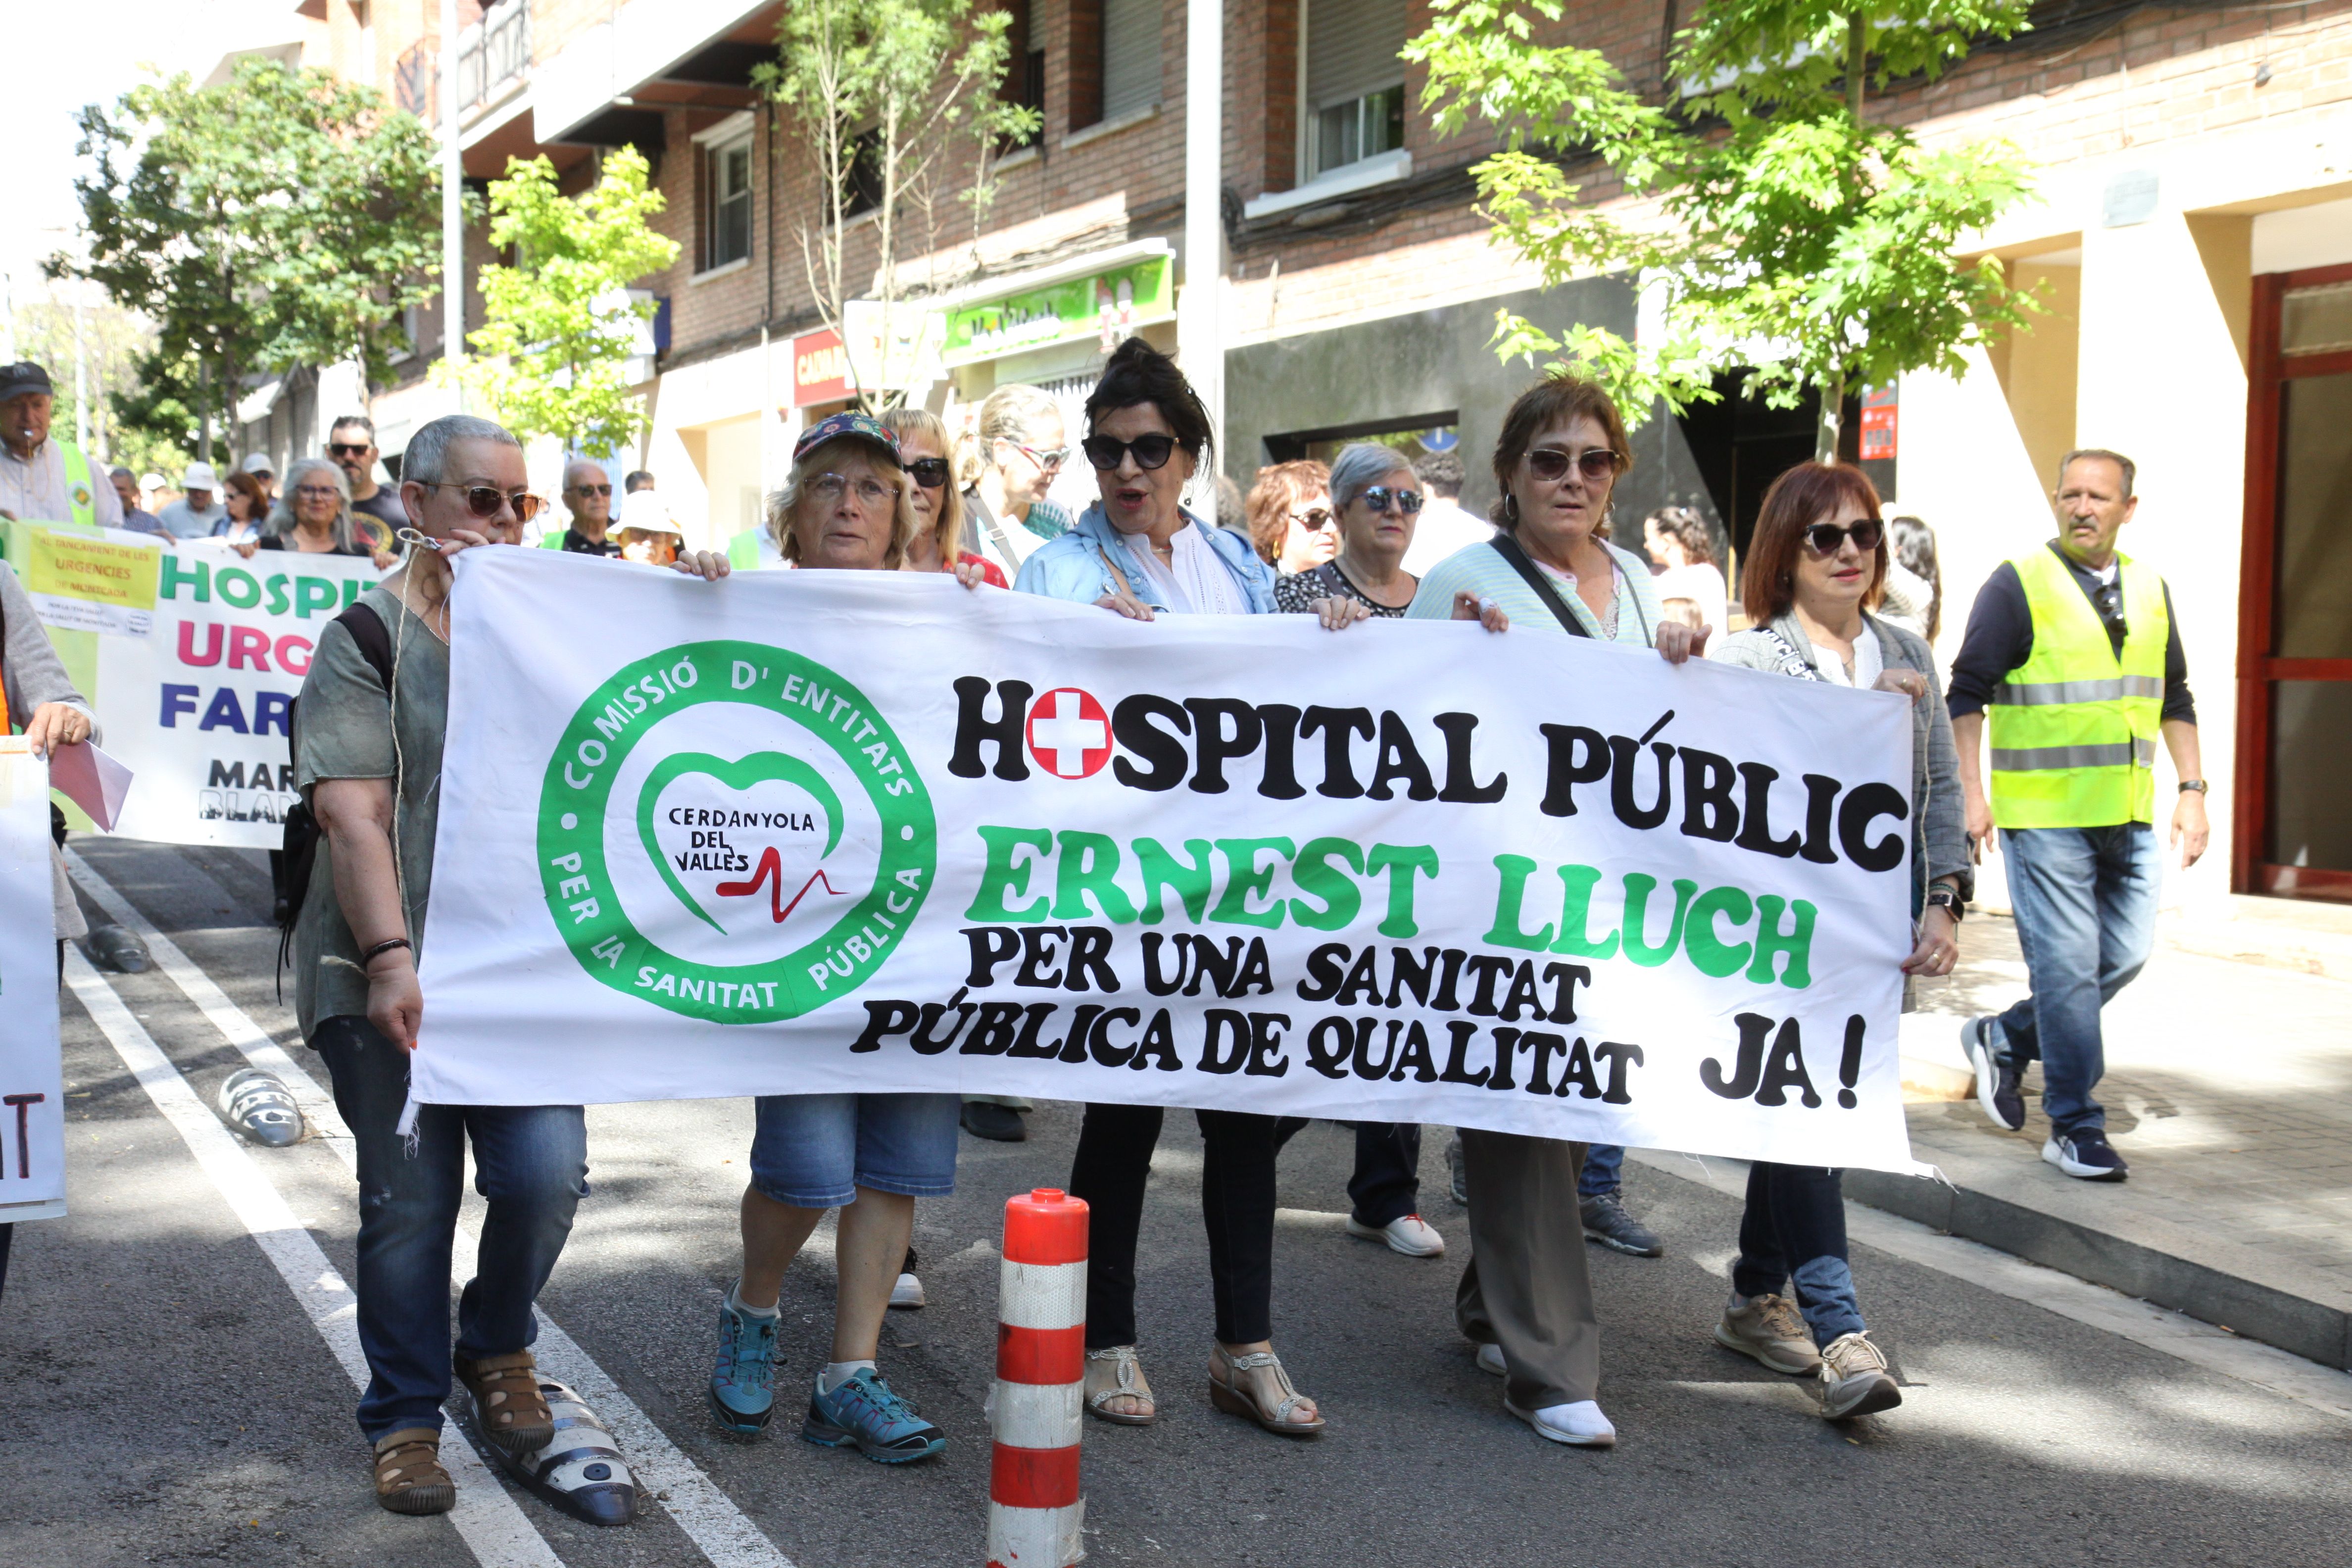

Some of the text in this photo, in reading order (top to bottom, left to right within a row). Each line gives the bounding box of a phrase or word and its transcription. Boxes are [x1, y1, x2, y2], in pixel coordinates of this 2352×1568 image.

[55, 557, 132, 580] URGENCIES
[160, 555, 379, 618] HOSPI
[178, 621, 315, 676] URG
[160, 683, 289, 737] FAR
[564, 655, 698, 789] COMISSIÓ
[781, 674, 914, 797] ENTITATS
[947, 676, 1909, 873] HOSPITAL PÚBLIC
[669, 808, 815, 831] CERDANYOLA
[691, 831, 730, 848] DEL
[551, 852, 922, 1010] PER LA SANITAT PÚBLICA
[964, 825, 1818, 989] ERNEST LLUCH
[959, 926, 1591, 1025] PER UNA SANITAT
[849, 986, 1645, 1105] PÚBLICA DE QUALITAT
